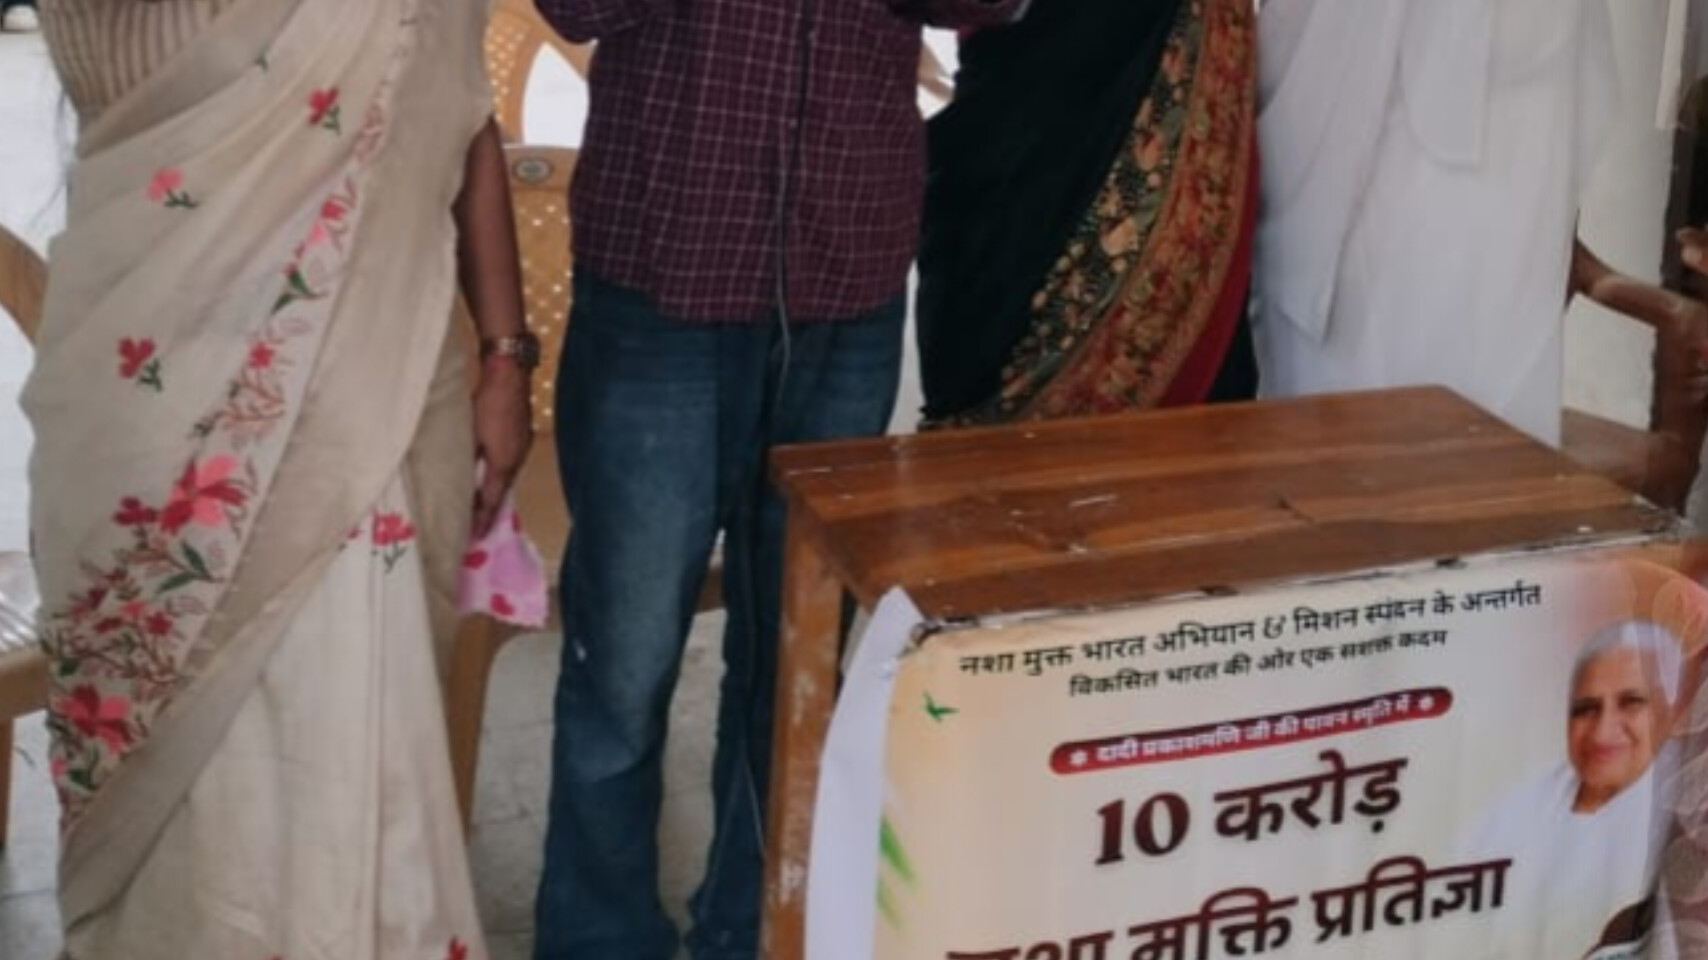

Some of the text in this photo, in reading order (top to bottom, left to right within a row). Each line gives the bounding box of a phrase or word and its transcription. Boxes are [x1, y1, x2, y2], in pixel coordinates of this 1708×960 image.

[959, 653, 1014, 676] नशा
[1022, 645, 1074, 677] मुक्त
[1081, 635, 1146, 661] भारत
[1153, 620, 1254, 652] अभियान
[1293, 606, 1358, 634] मिशन
[1364, 595, 1425, 624] स्पंदन
[1432, 589, 1455, 614] के
[1461, 579, 1541, 612] अन्तर्गत
[1069, 629, 1448, 697] विकसित भारत की ओर एक सशक्त कदम
[1097, 736, 1137, 761] दादी
[1244, 719, 1270, 741] जी
[1275, 715, 1299, 735] की
[1095, 749, 1409, 865] 10 करोड़
[1127, 856, 1513, 960] मक्ति प्रतिज्ञा
